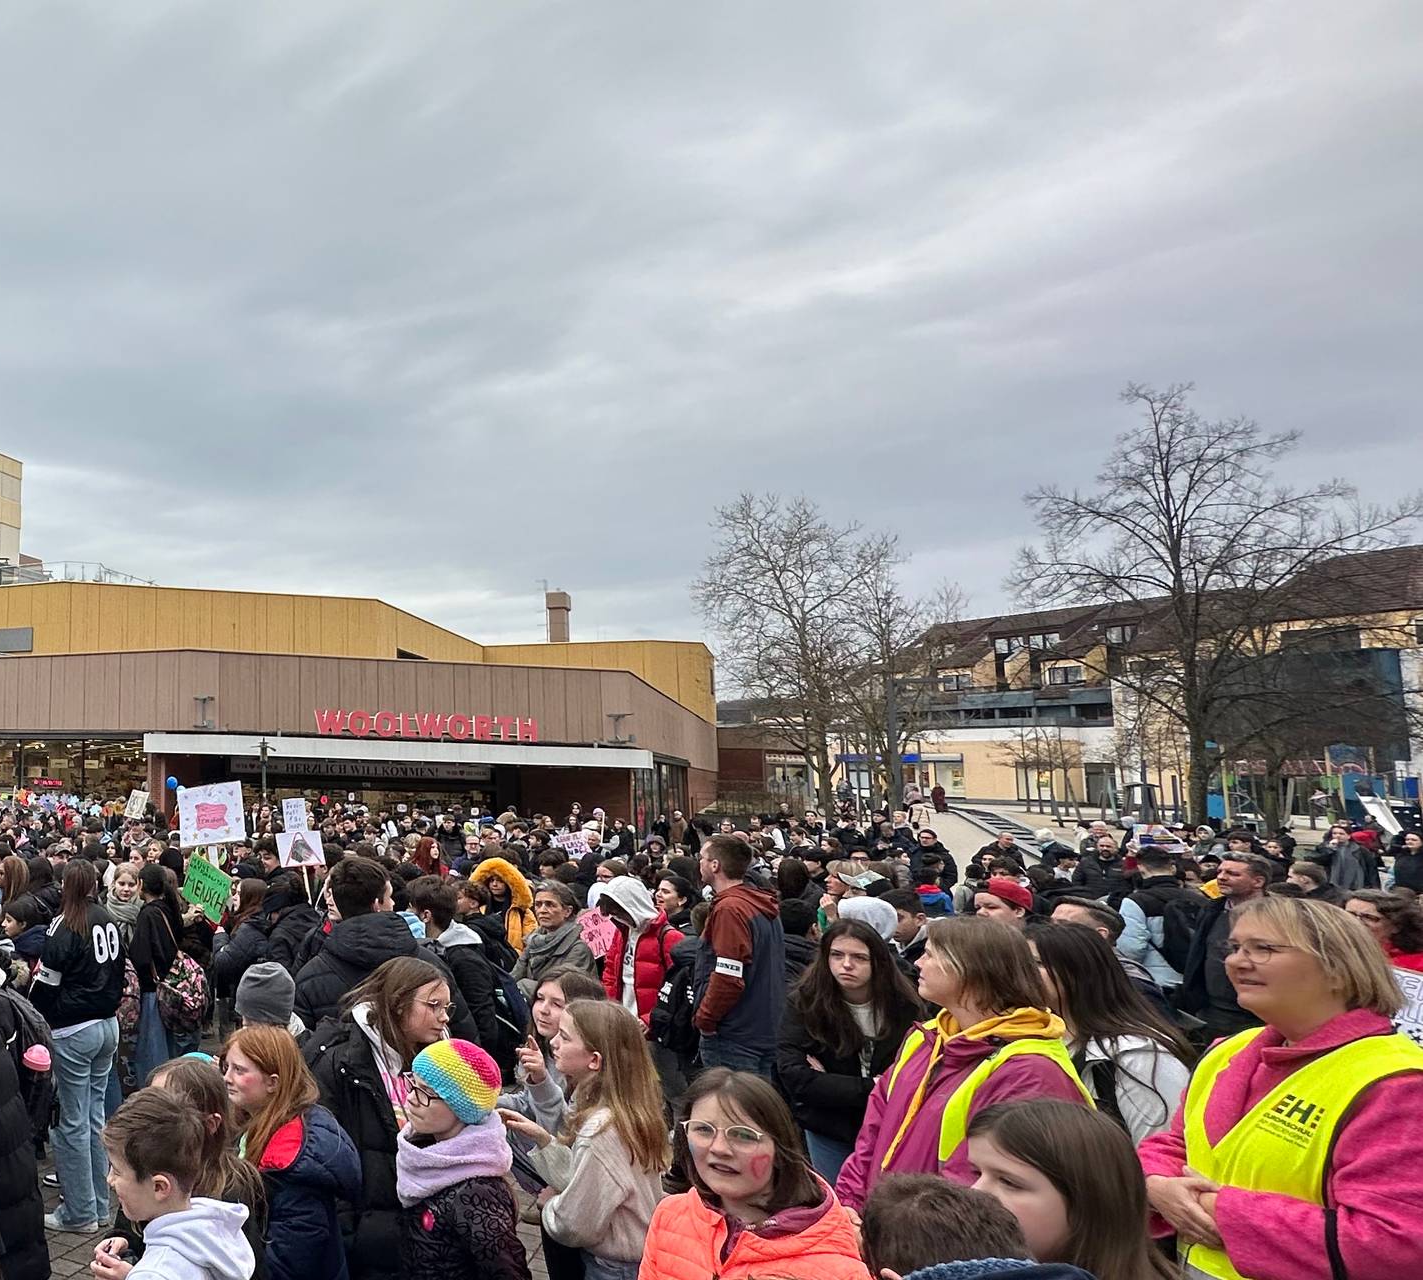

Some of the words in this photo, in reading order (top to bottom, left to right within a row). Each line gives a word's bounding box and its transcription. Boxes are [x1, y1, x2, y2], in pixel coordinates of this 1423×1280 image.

[314, 709, 539, 742] WOOLWORTH
[285, 763, 347, 775] HERZLICH
[350, 765, 439, 778] WILLKOMMEN!
[183, 876, 225, 913] MENSCH
[92, 922, 120, 964] 00
